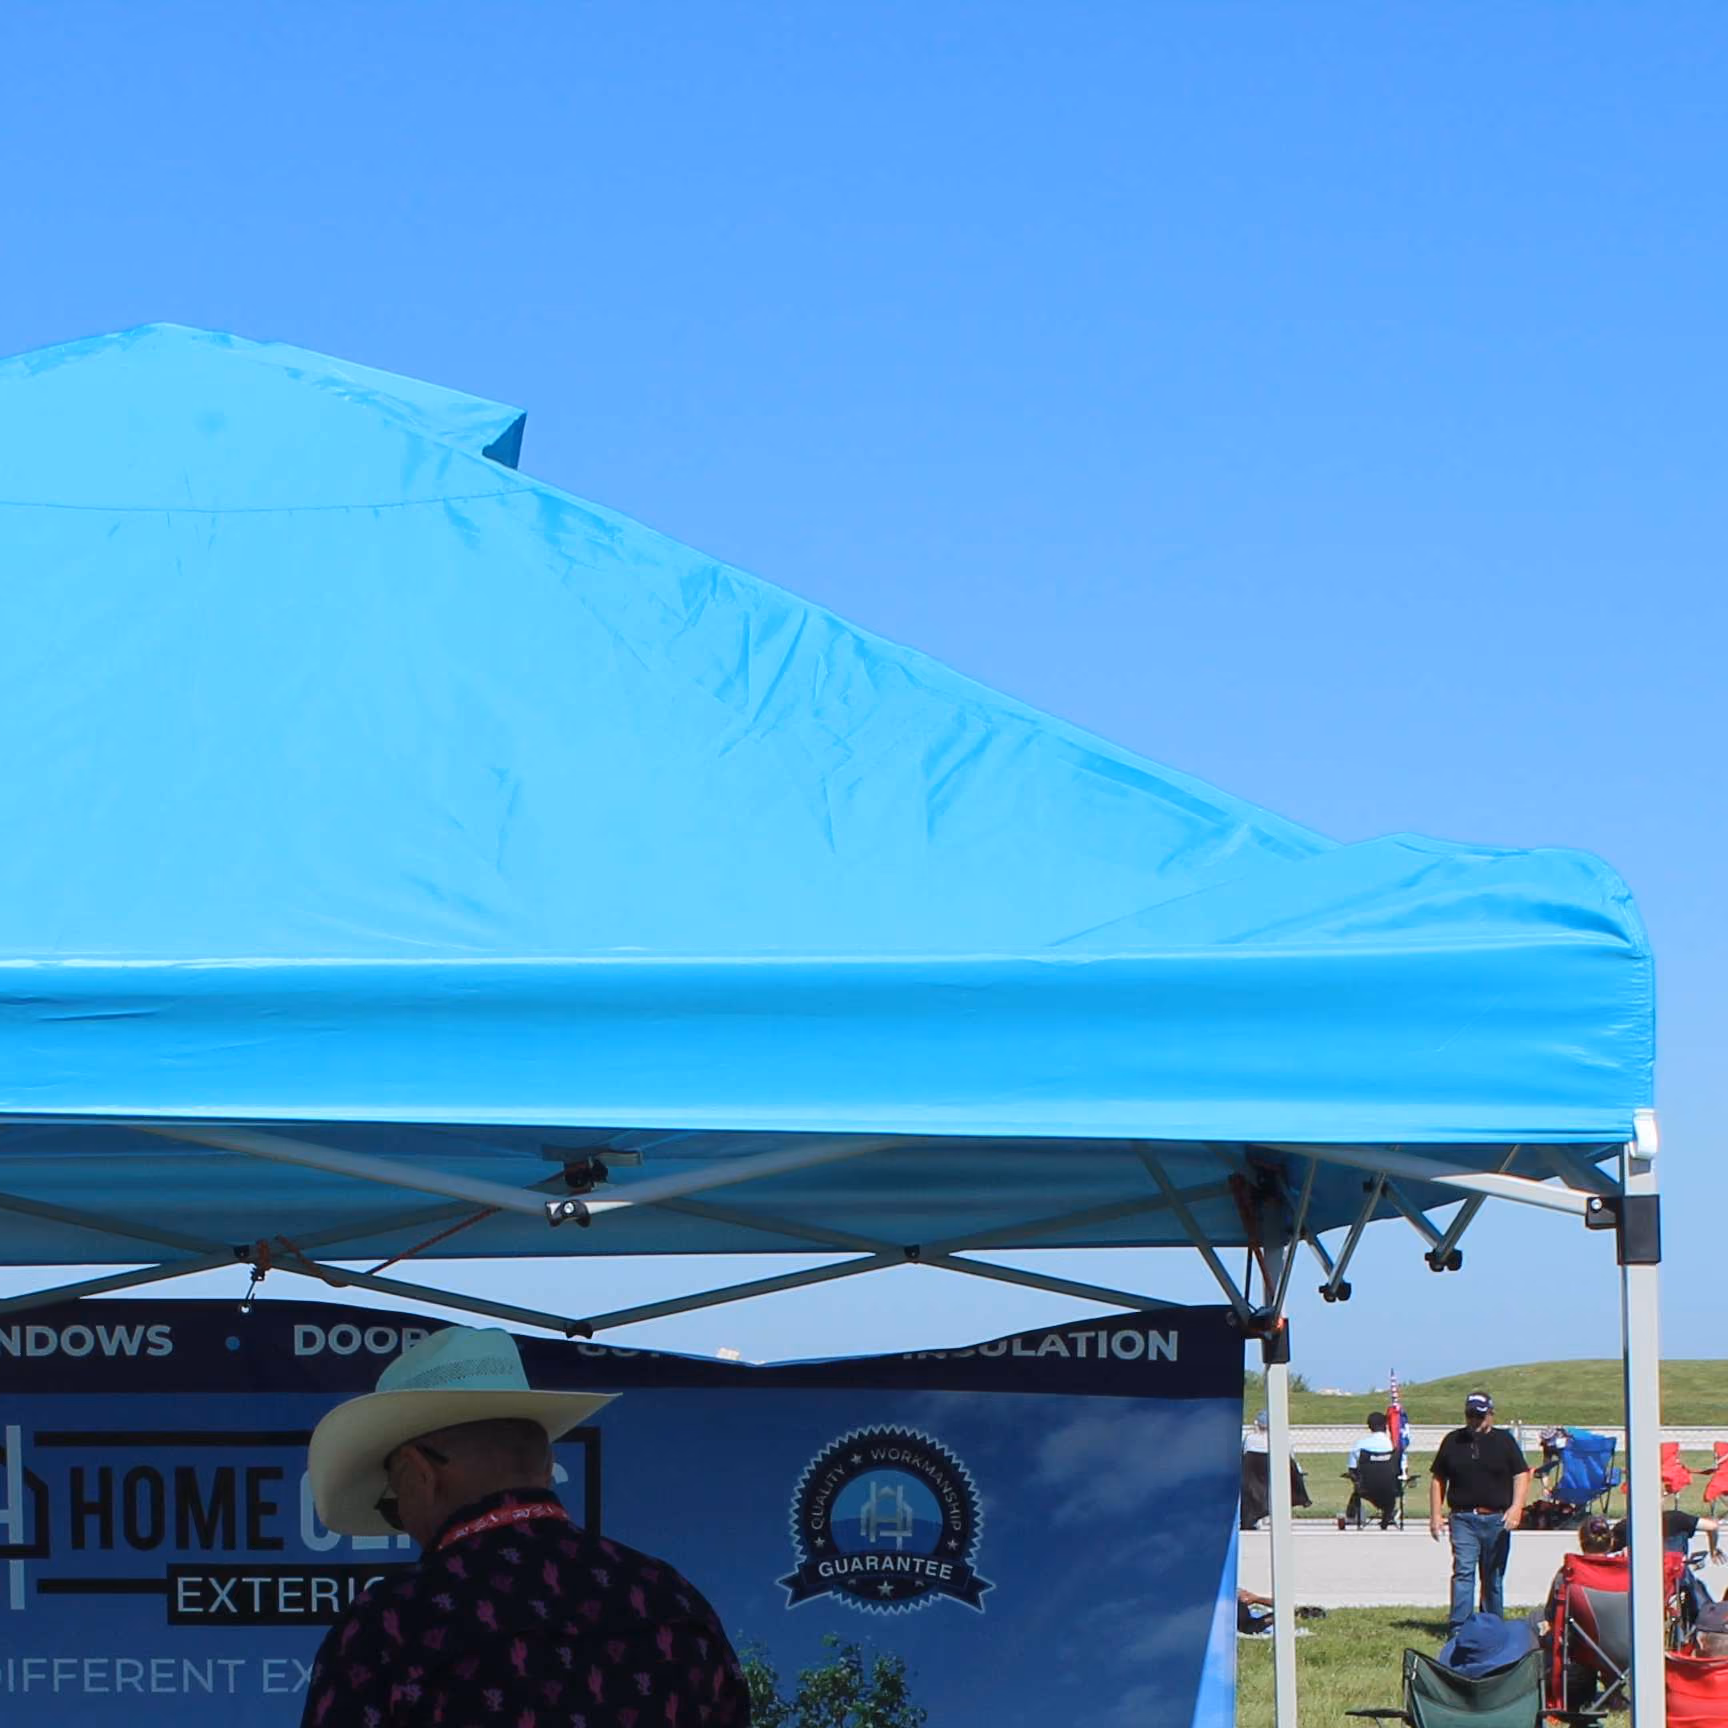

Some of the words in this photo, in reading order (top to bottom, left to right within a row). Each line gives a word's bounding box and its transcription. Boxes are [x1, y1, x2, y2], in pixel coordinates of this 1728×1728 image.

[902, 1329, 1178, 1362] ULATION
[69, 1464, 285, 1552] HOME
[810, 1462, 846, 1531] QUALITY
[870, 1447, 963, 1532] WORKMANSHIP
[817, 1555, 954, 1581] GUARANTEE
